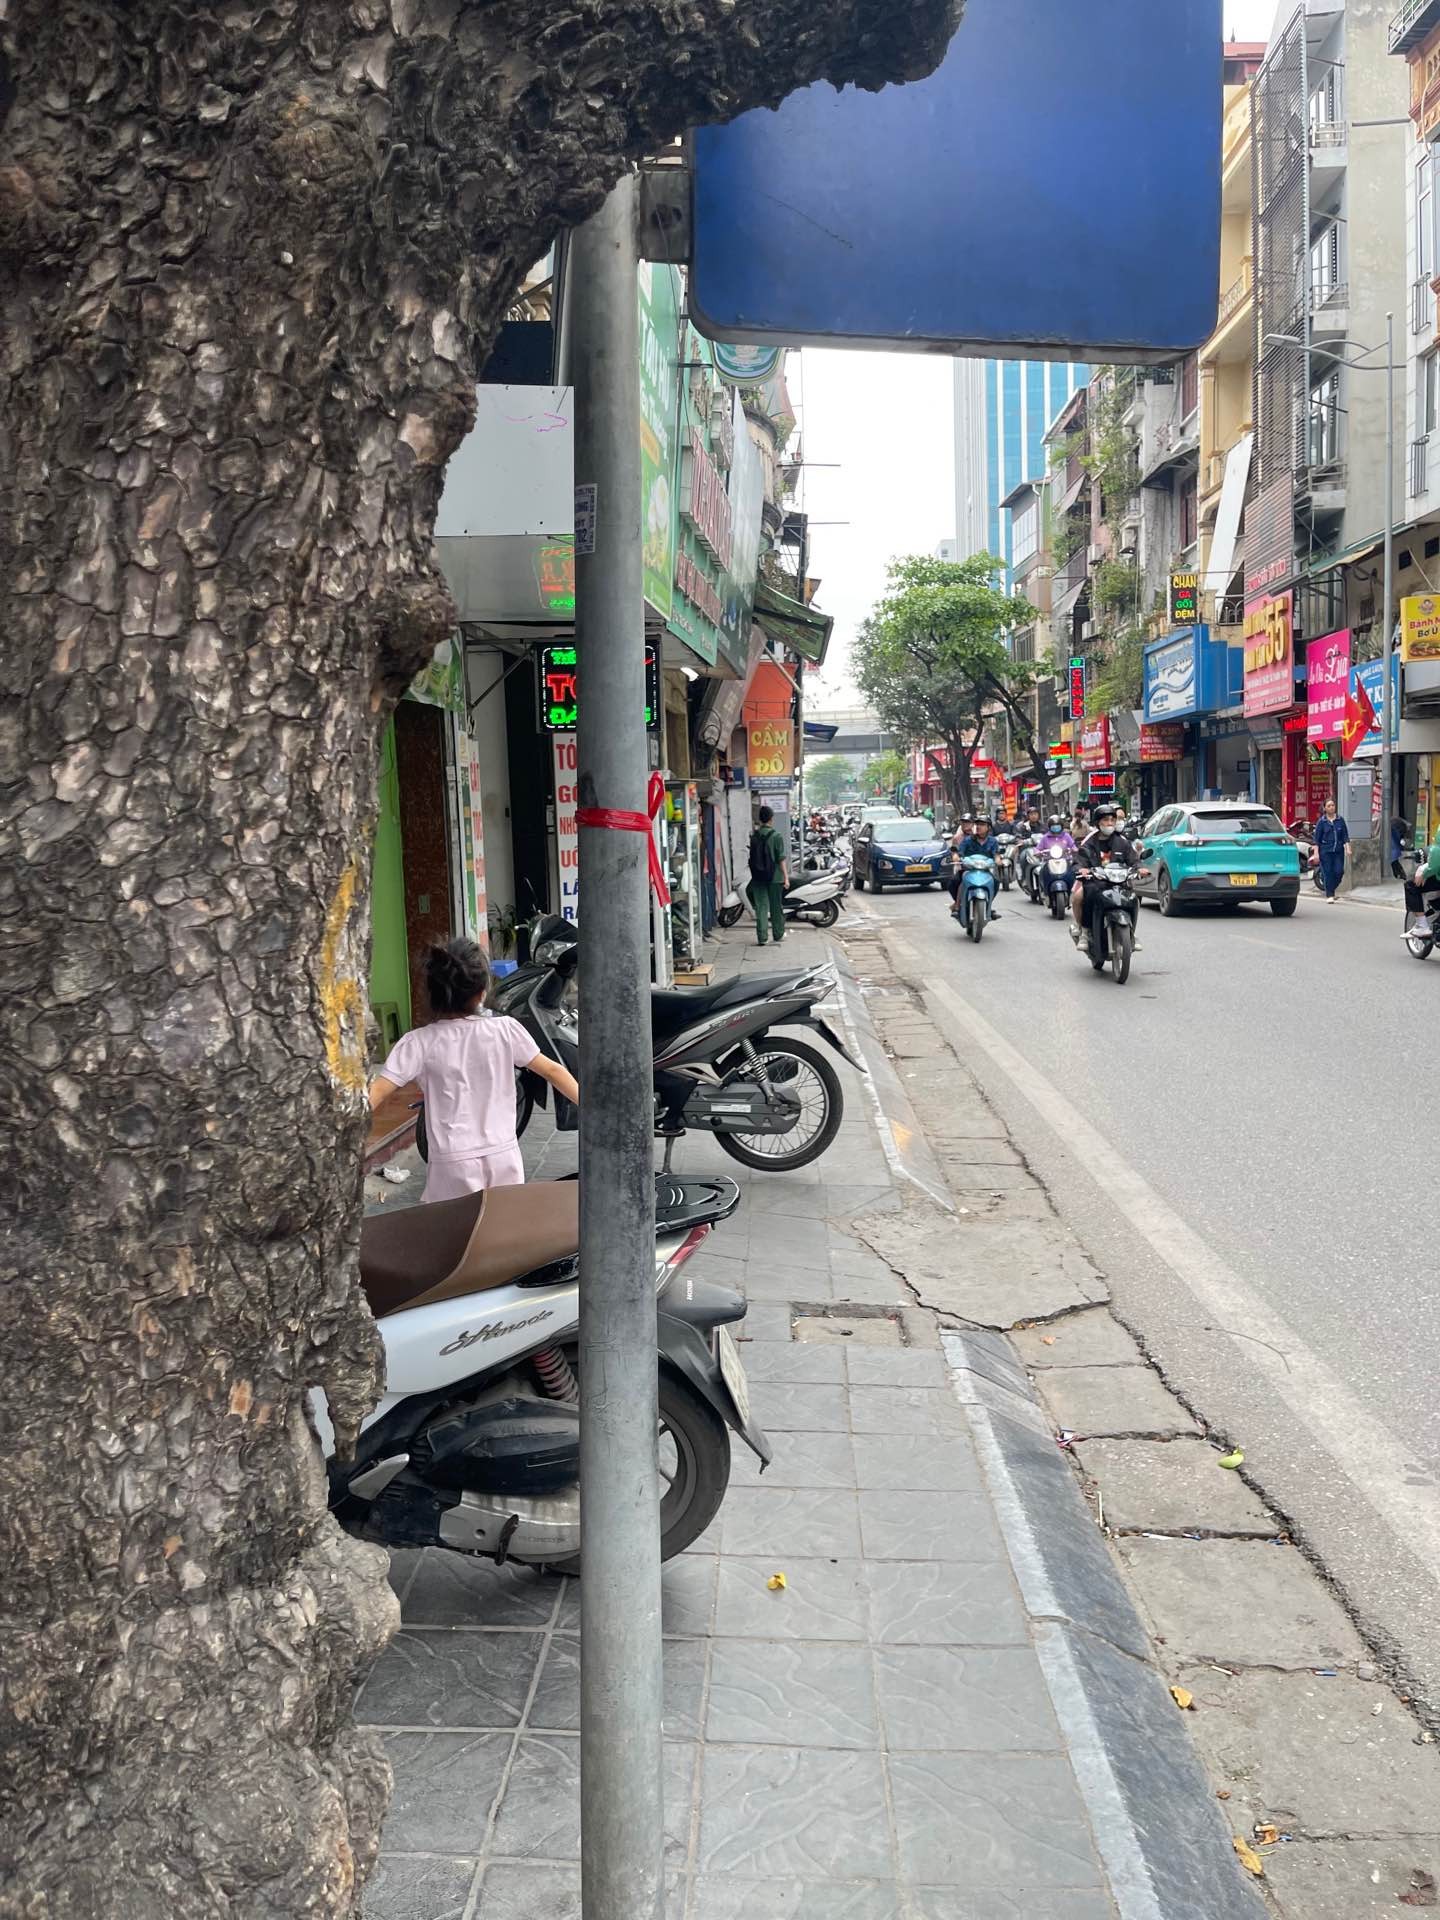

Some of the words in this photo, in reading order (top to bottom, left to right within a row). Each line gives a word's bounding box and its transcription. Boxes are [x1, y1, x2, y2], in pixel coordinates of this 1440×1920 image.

[1266, 598, 1287, 664] 55
[752, 722, 788, 747] CẦM
[757, 749, 784, 773] ĐỒ
